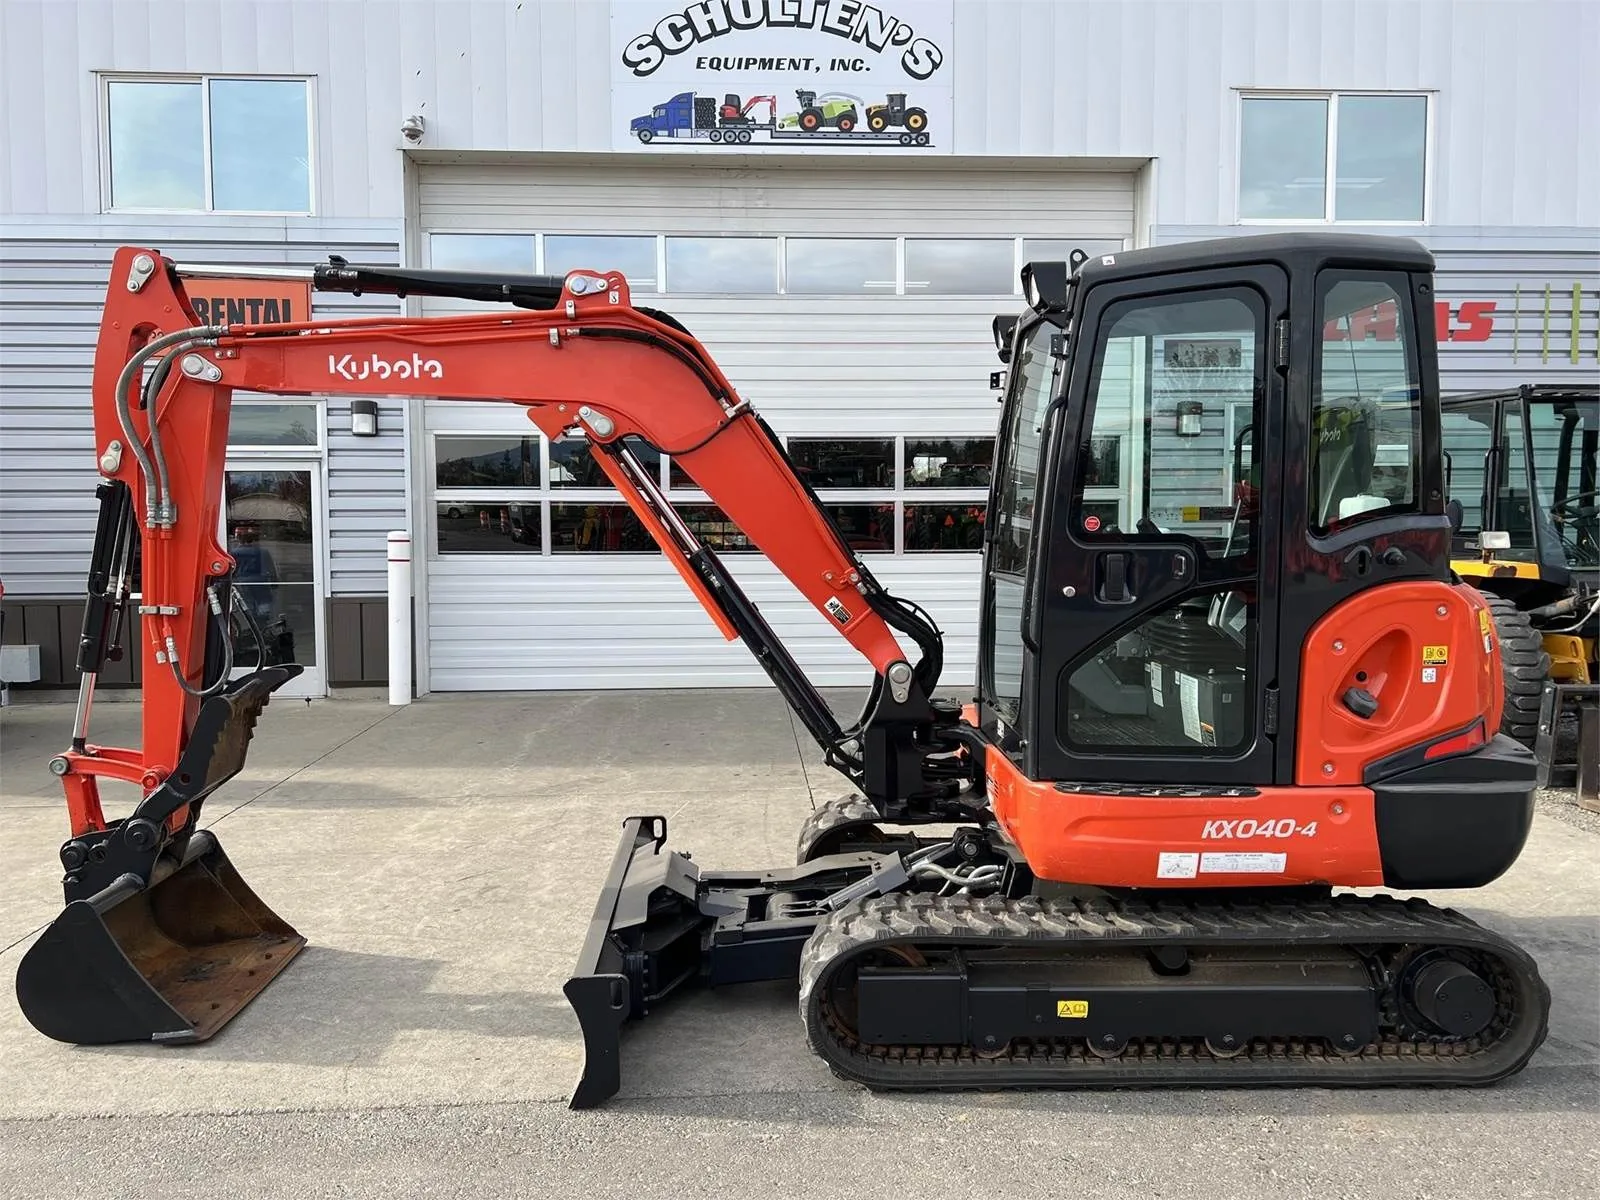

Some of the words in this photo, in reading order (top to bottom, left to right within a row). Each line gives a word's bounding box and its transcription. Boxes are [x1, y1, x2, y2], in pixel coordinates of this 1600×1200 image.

[622, 0, 943, 80] SCHOLTEN'S
[696, 57, 820, 73] EQUIPMENT,
[829, 58, 871, 72] INC.
[328, 352, 443, 380] Kubota
[1201, 819, 1318, 839] KX040-4
